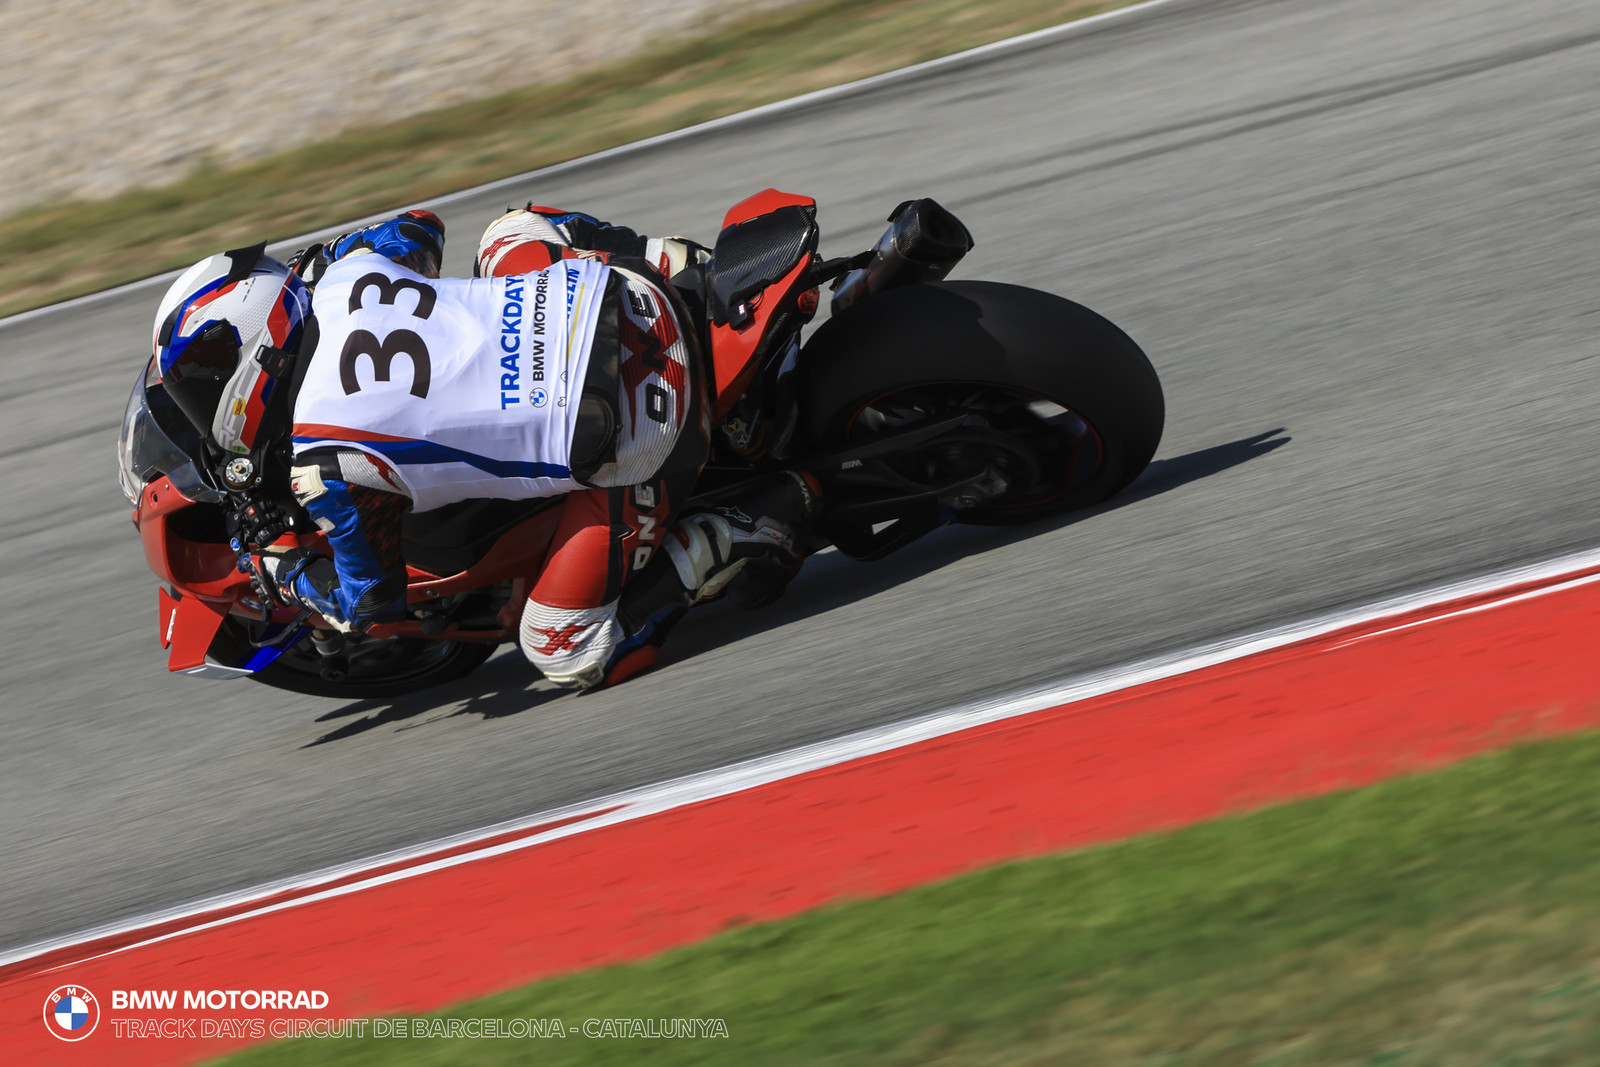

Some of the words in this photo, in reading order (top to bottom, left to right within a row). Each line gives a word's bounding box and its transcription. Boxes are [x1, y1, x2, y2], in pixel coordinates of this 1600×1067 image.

[339, 271, 437, 399] 33
[500, 273, 525, 410] TRACKDAY
[533, 269, 550, 336] MOTORRA
[532, 340, 545, 381] BMW
